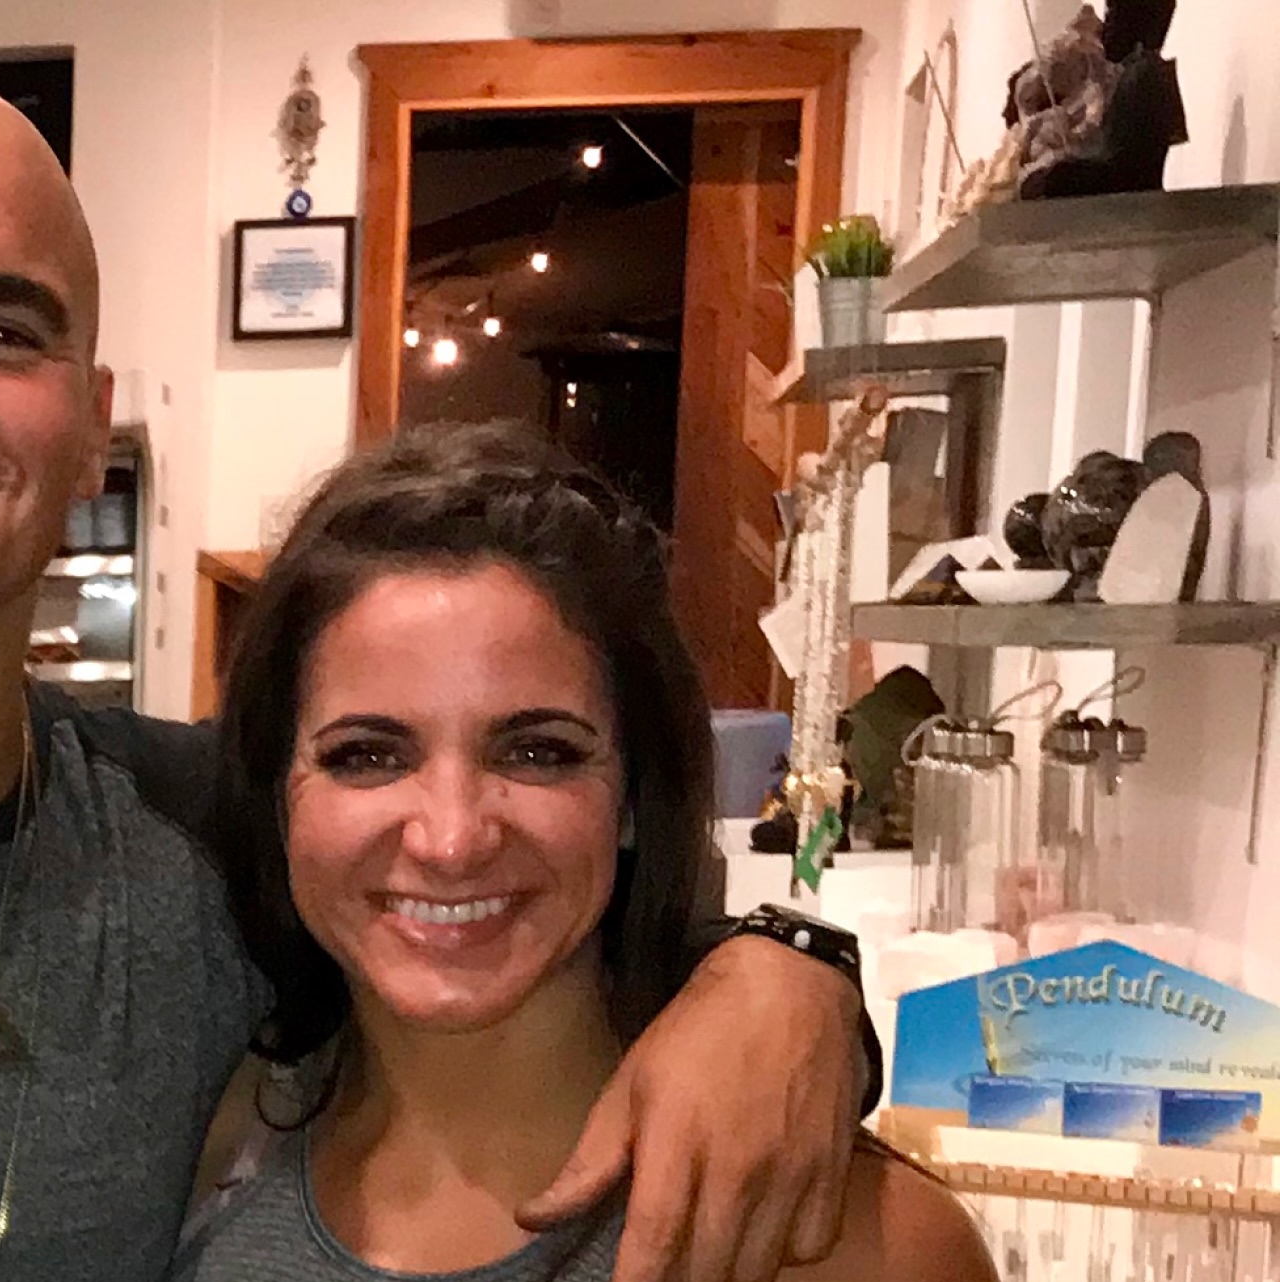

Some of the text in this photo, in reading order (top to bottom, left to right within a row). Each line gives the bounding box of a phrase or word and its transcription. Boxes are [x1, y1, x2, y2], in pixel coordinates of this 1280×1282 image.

[991, 964, 1227, 1033] Pendulum
[1120, 1054, 1162, 1075] your
[1169, 1056, 1212, 1075] mind
